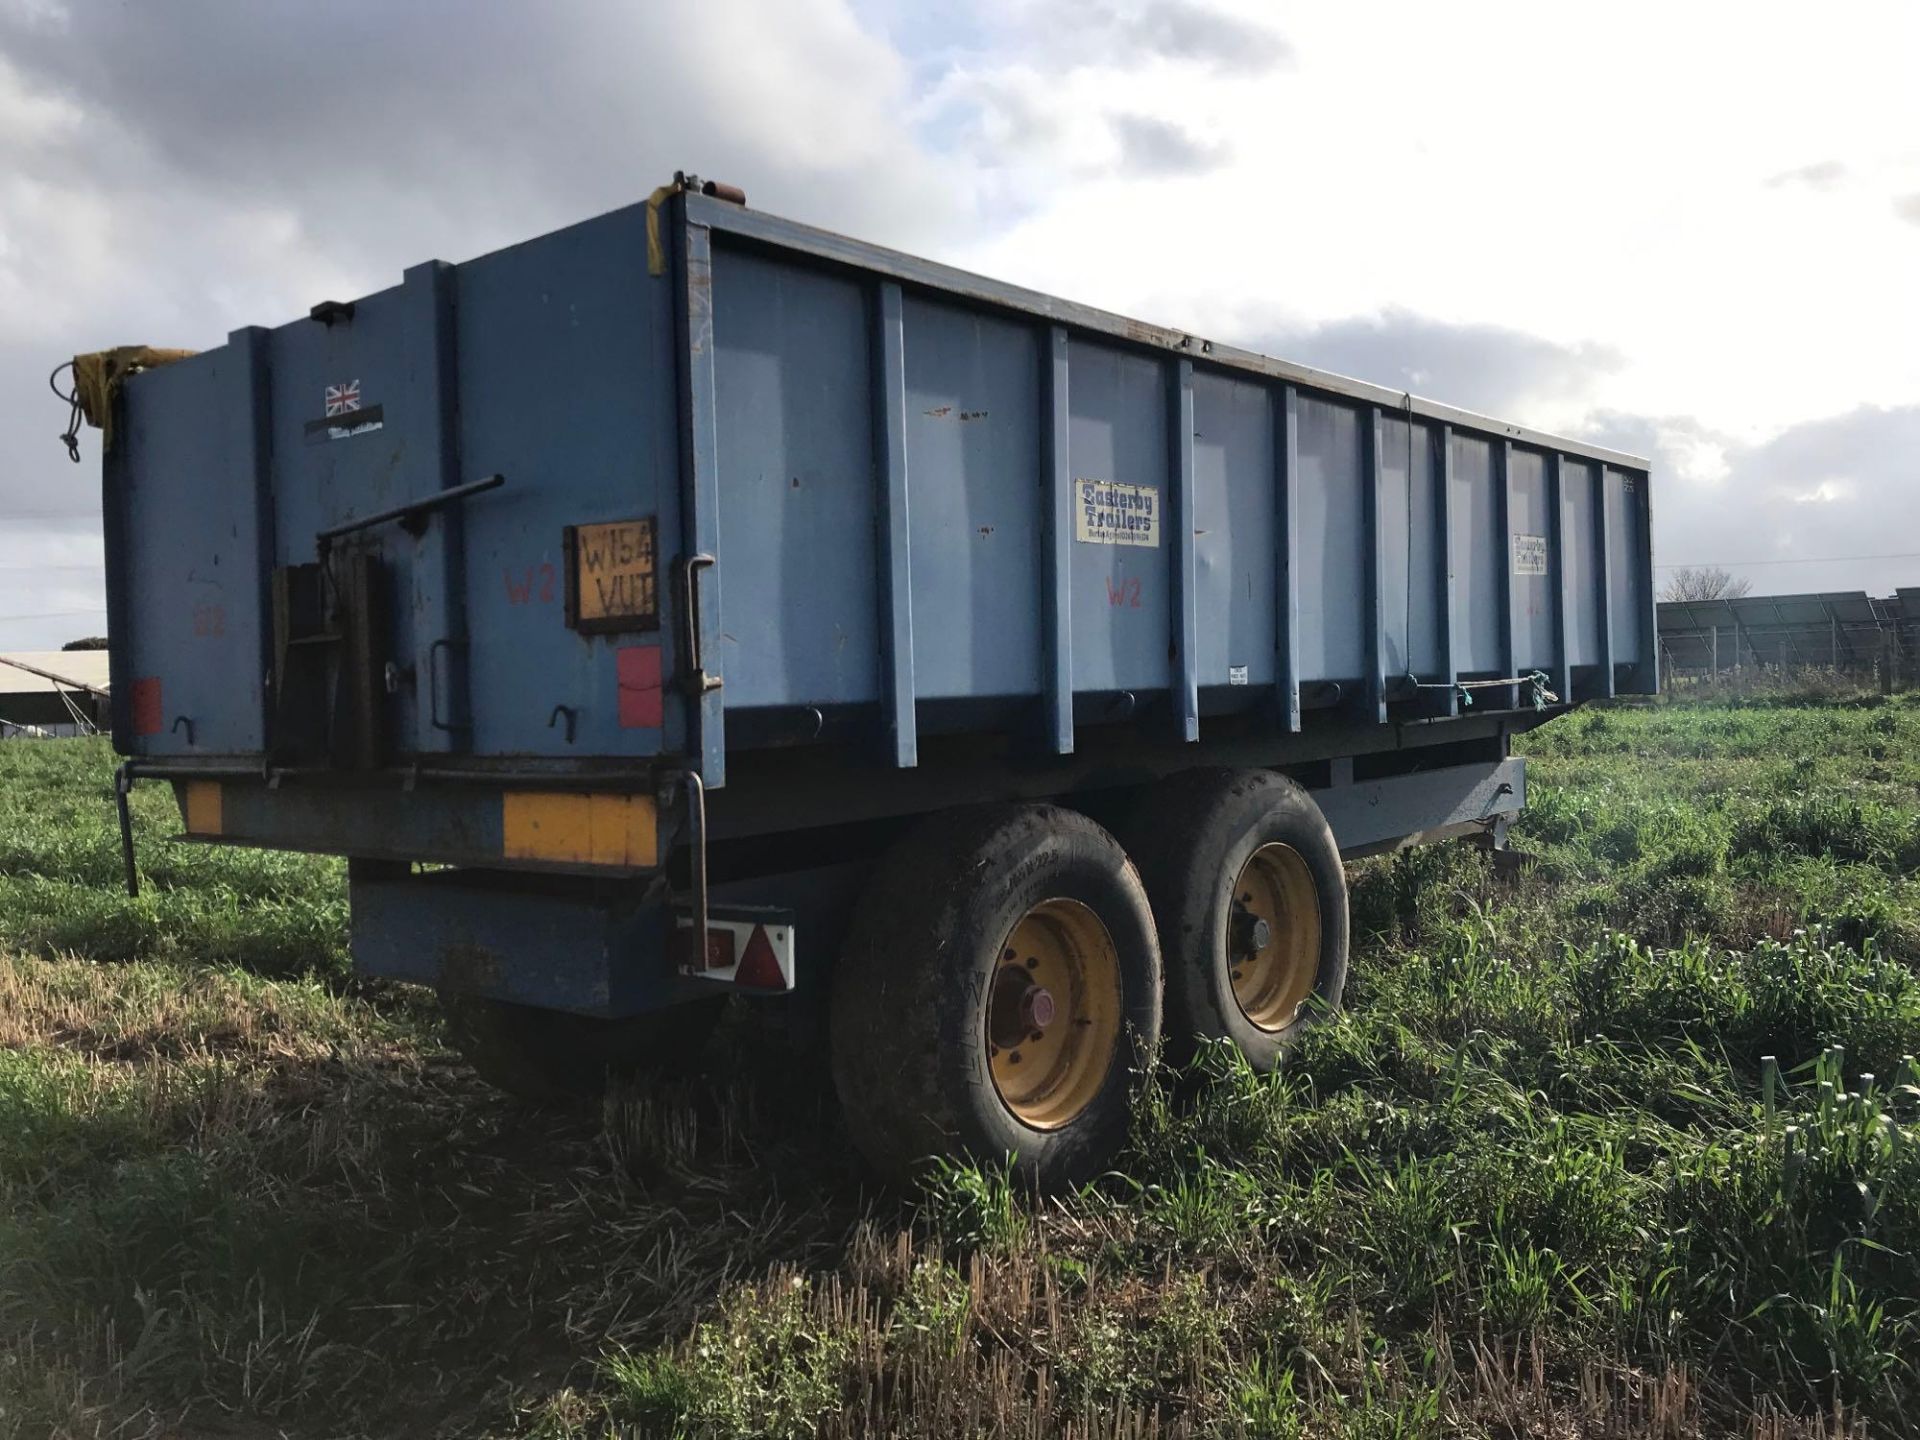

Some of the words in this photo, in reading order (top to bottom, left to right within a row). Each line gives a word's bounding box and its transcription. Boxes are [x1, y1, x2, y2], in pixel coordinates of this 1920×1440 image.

[1082, 484, 1153, 515] Easterby
[1085, 506, 1152, 532] Trailers
[582, 525, 650, 573] W154
[503, 562, 556, 607] W2
[1106, 575, 1142, 608] W2
